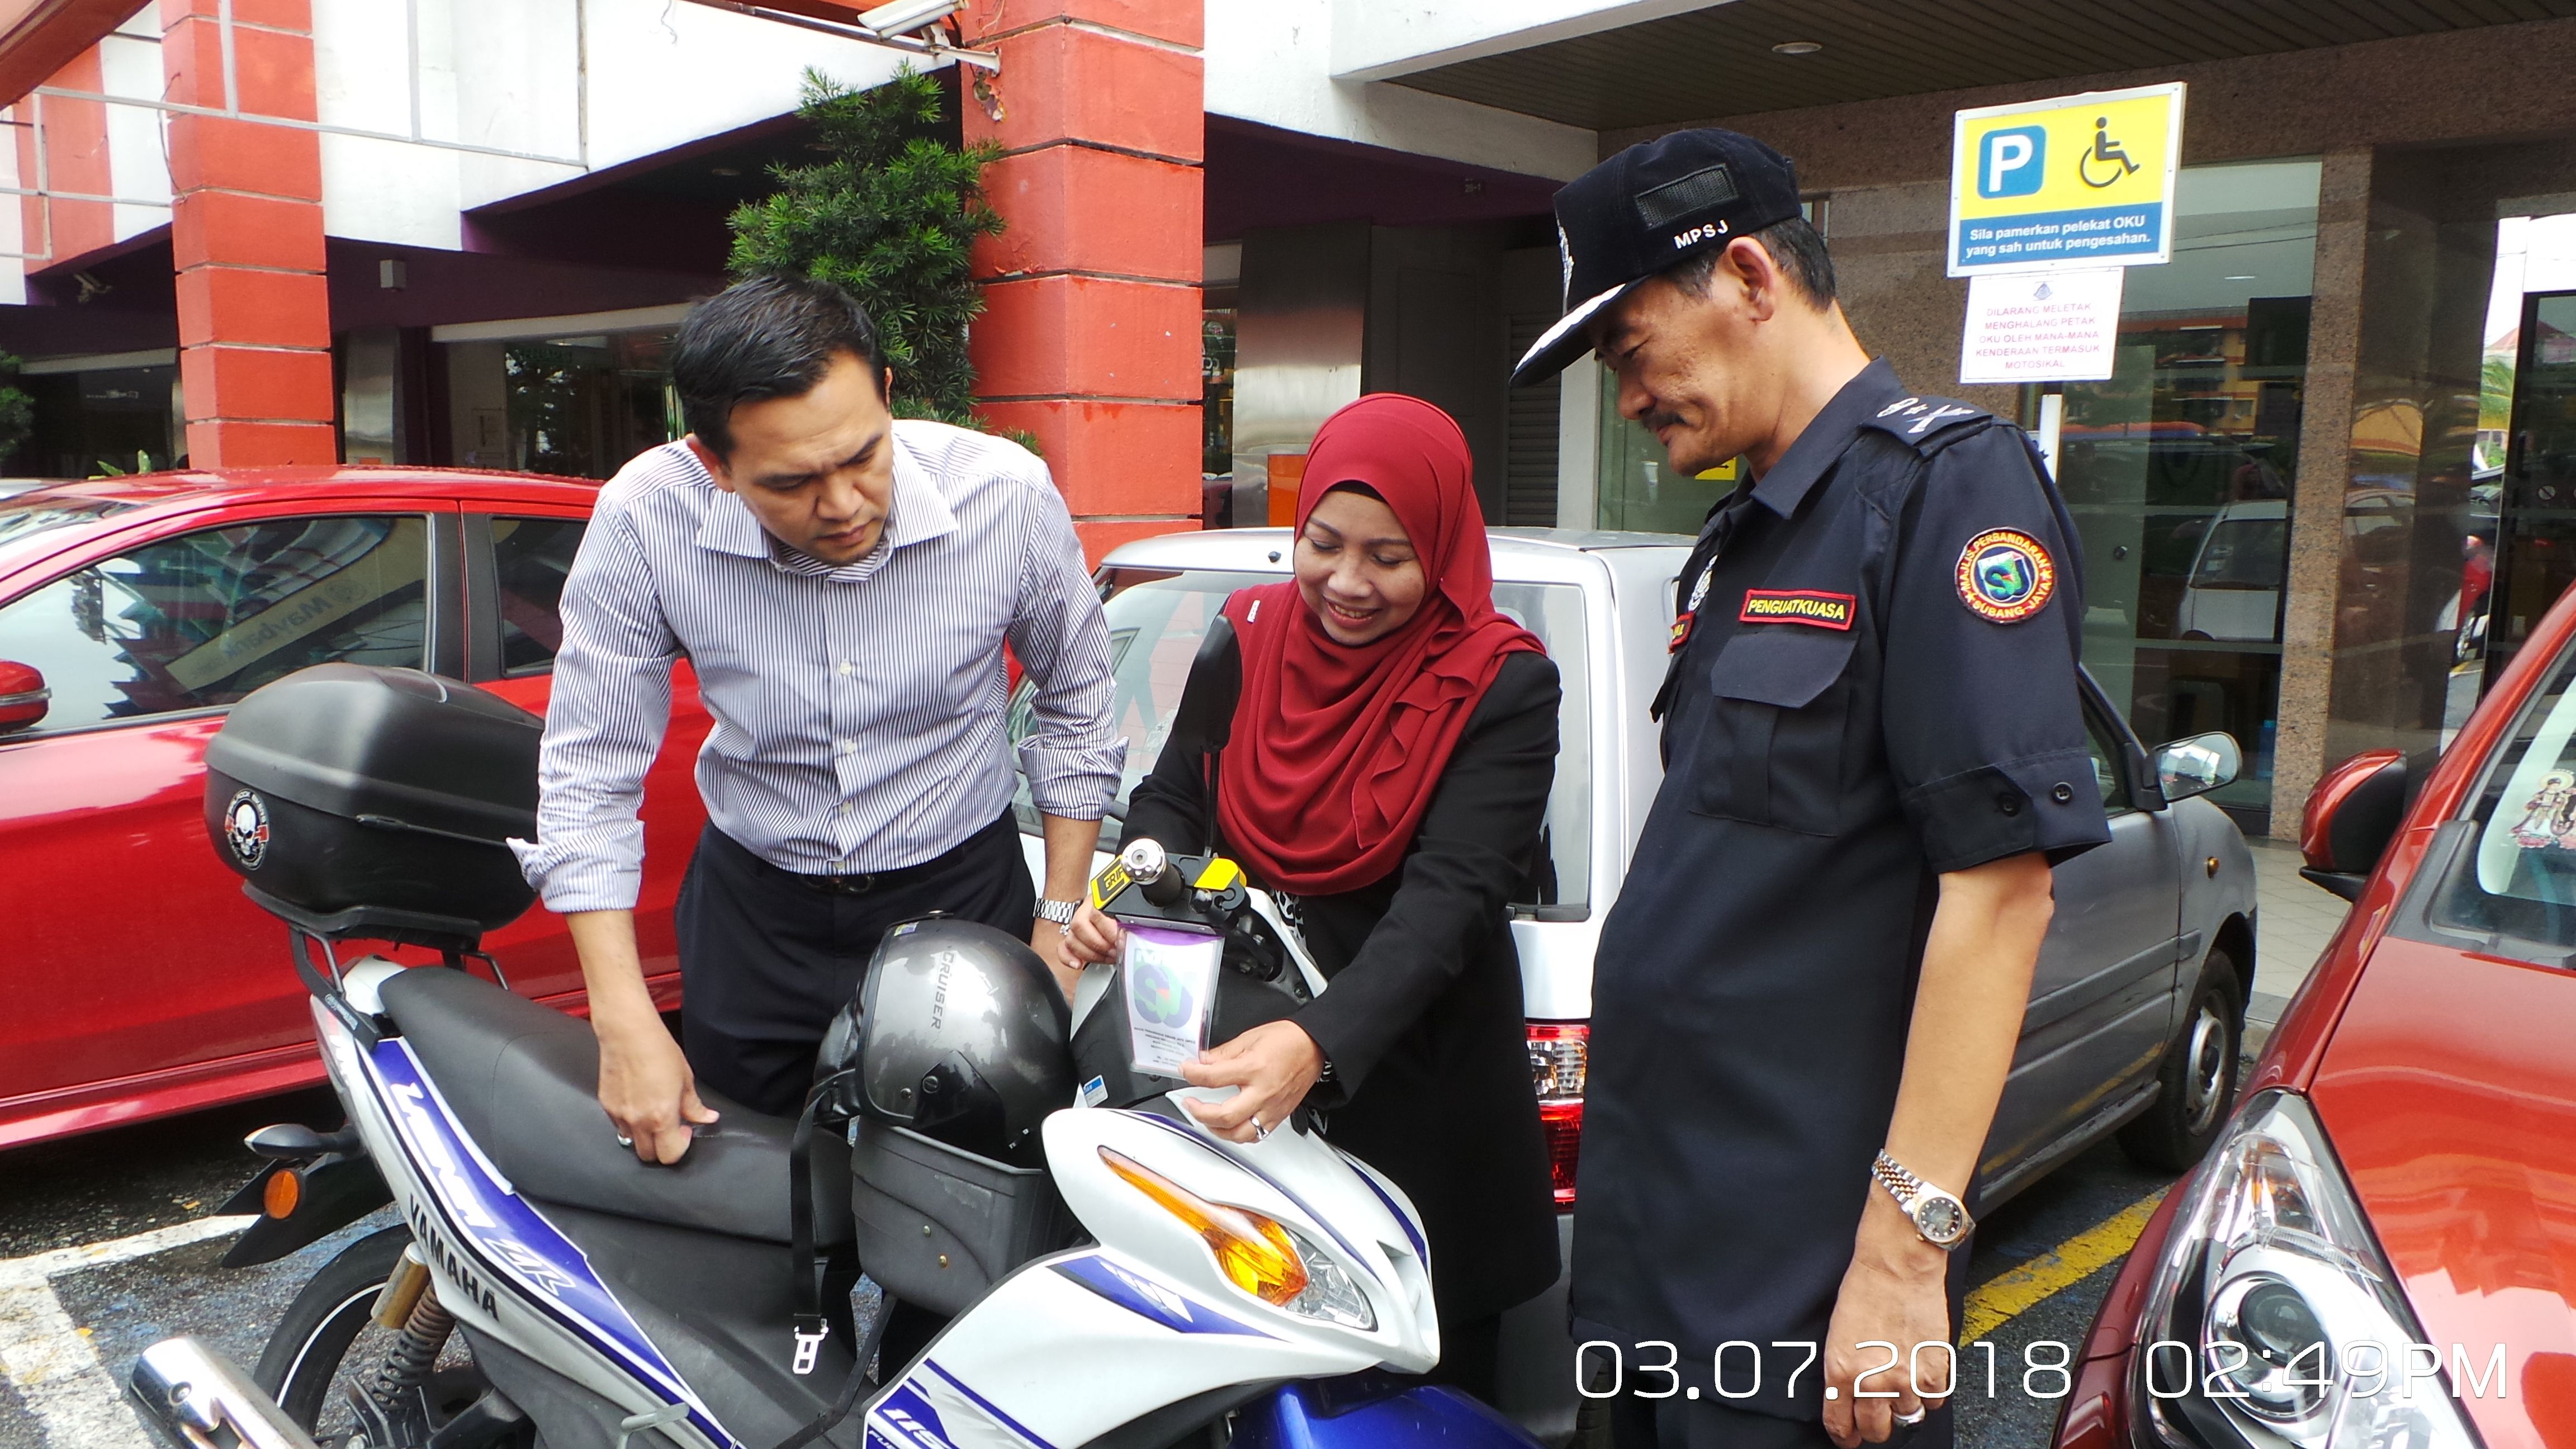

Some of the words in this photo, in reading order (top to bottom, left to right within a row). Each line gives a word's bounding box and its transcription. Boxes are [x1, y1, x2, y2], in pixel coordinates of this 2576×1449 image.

[1988, 134, 2033, 192] P
[1673, 220, 1729, 249] MPSJ
[1970, 229, 1993, 240] Sila
[1996, 224, 2059, 241] pamerkan
[2062, 219, 2111, 235] pelekat
[2113, 215, 2146, 229] OKU
[1966, 245, 1996, 258] yang
[1999, 242, 2021, 253] sah
[2026, 238, 2062, 251] untuk
[2066, 233, 2151, 250] pengesahan.
[1987, 306, 2040, 316] DILARANG
[2043, 302, 2091, 313] MELETAK
[1985, 319, 2058, 330] MENGHALANG
[2061, 317, 2096, 326] PETAK
[2004, 334, 2032, 343] OLEH
[2035, 331, 2099, 341] MANA-MANA
[1976, 347, 2039, 357] KENDERAAN
[2042, 344, 2100, 354] TERMASUK
[2005, 360, 2065, 369] MOTOSIKAL
[1959, 550, 1975, 591] MAJLIS
[1973, 532, 2051, 567] PERBANDARAN
[1747, 599, 1845, 619] PENGUATKUASA
[1973, 600, 2025, 618] SUBANG
[2025, 581, 2052, 609] JAYA
[931, 952, 955, 1030] CRUISER
[410, 1192, 499, 1322] YAMAHA
